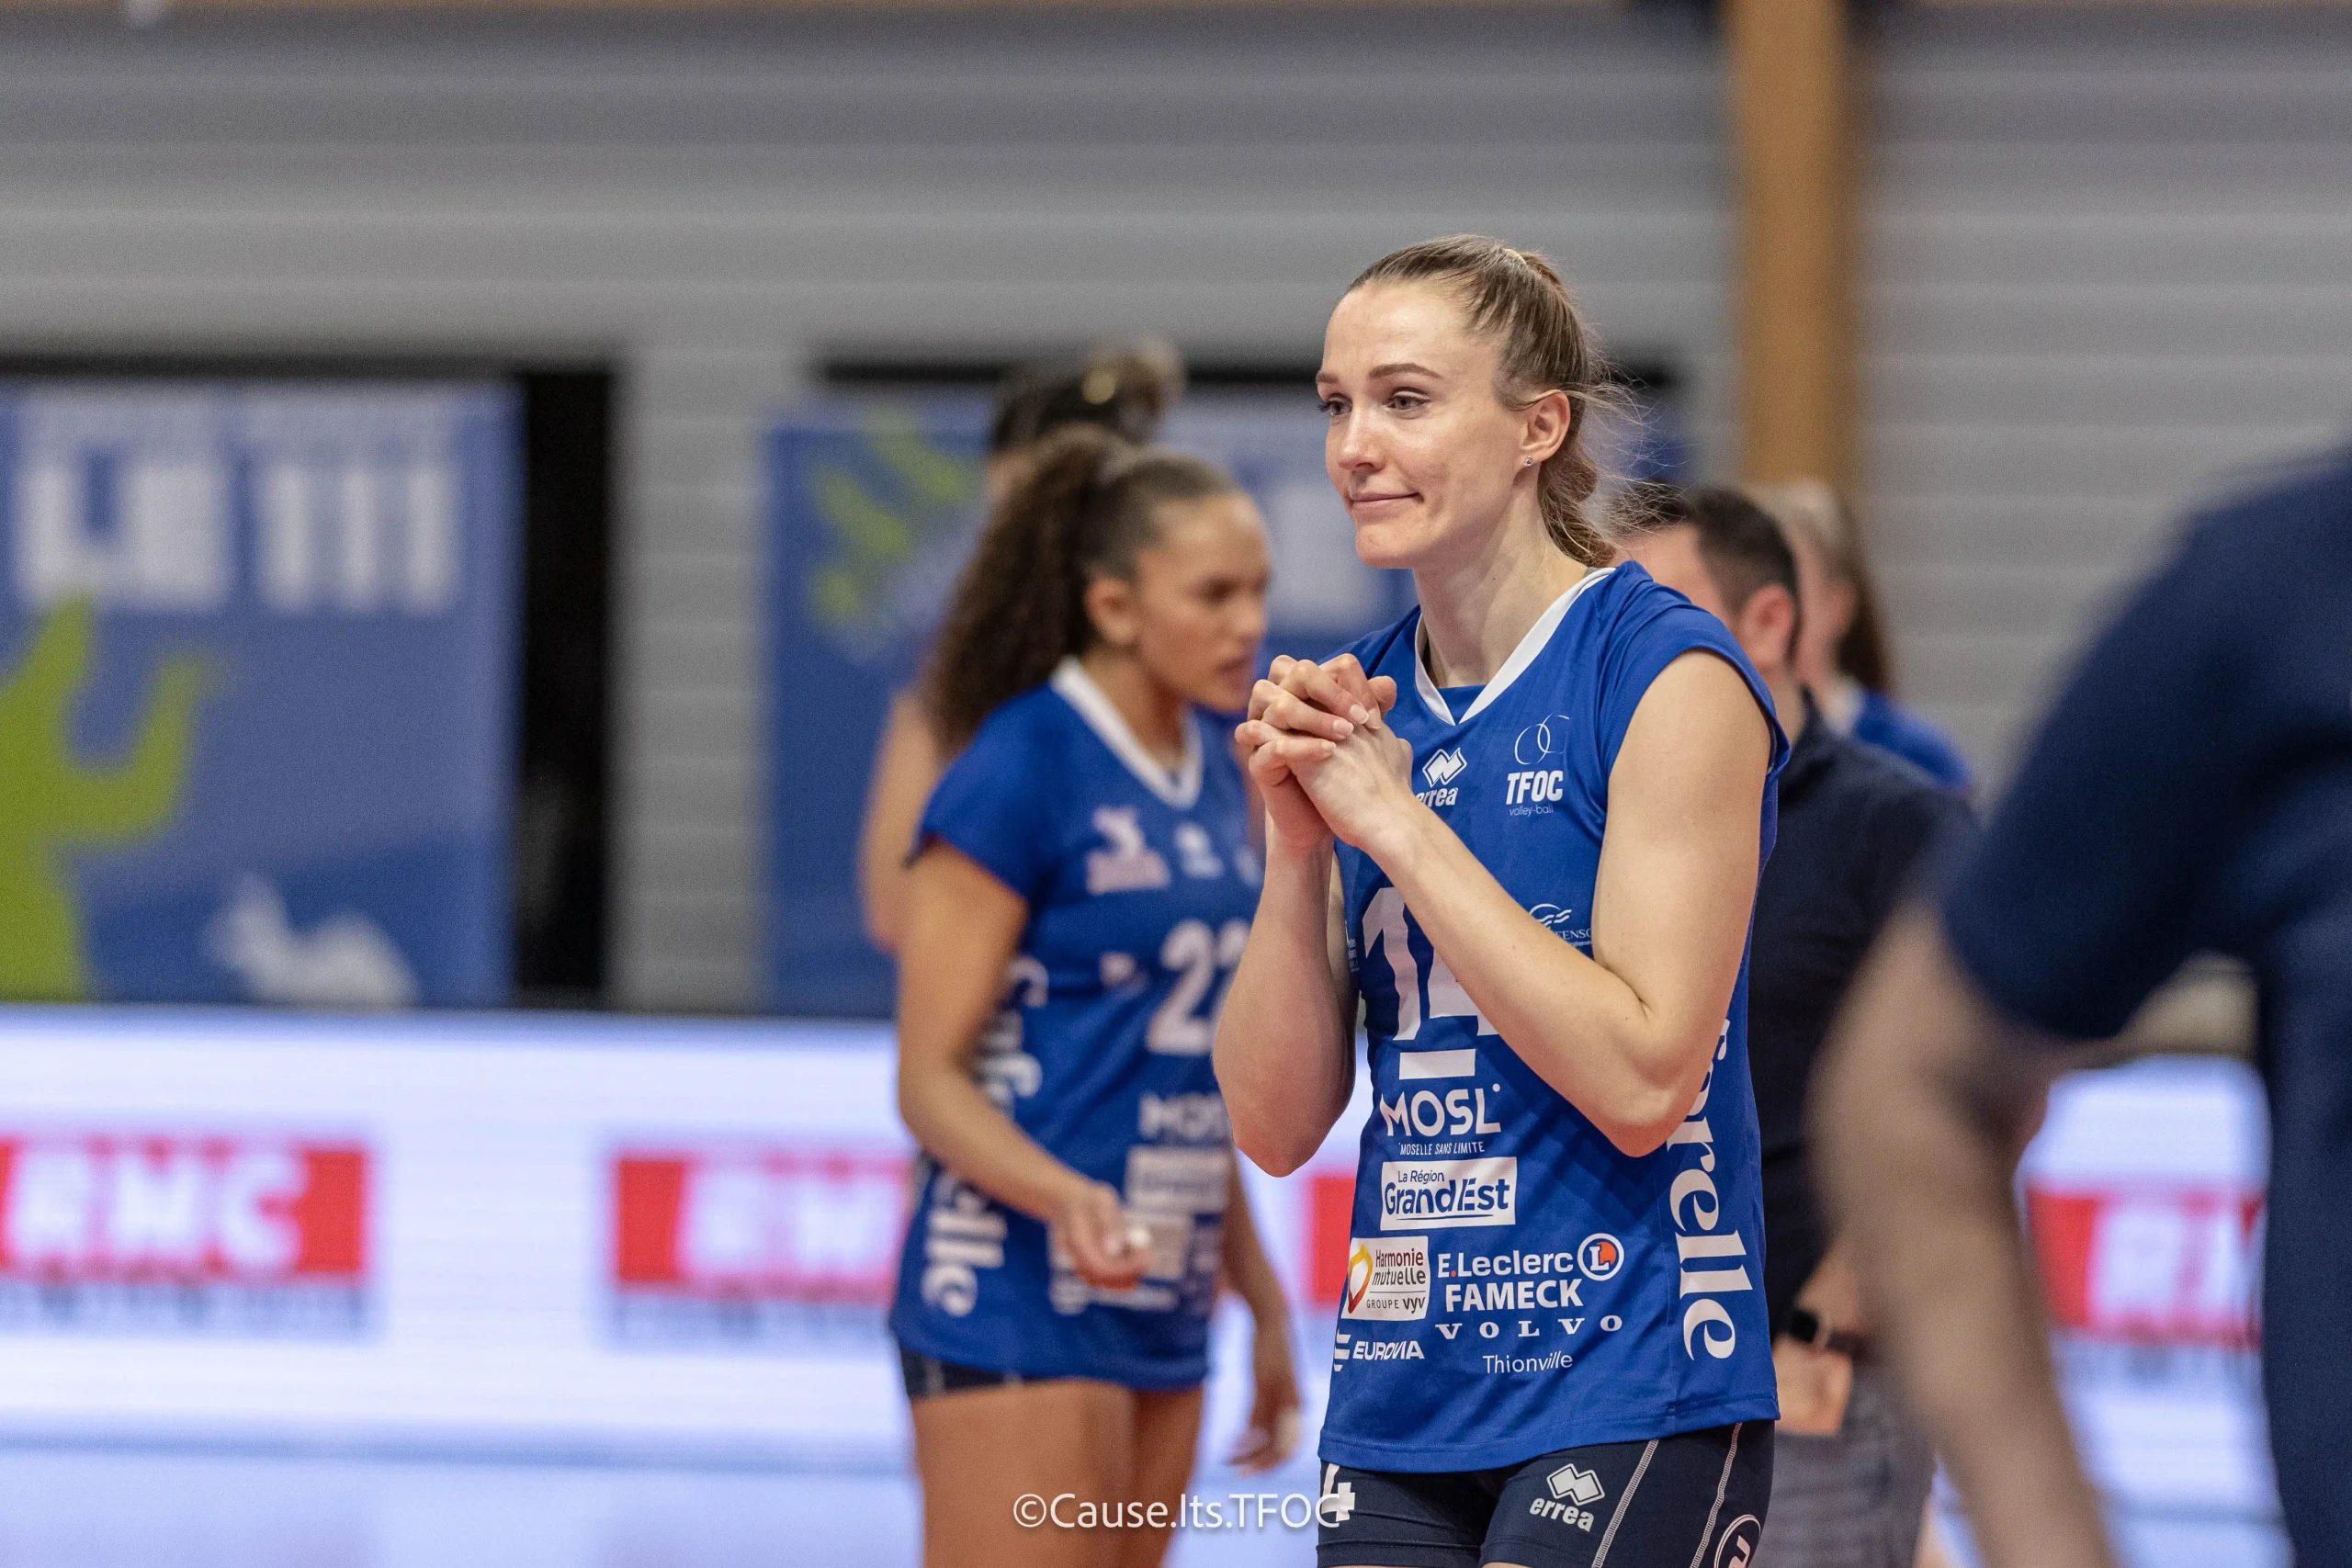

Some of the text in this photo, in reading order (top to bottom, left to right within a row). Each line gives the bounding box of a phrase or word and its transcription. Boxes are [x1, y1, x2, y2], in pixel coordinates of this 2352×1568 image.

[1506, 770, 1564, 805] TFOC
[1509, 803, 1555, 817] volley-ball
[1379, 1088, 1502, 1137] MOSL
[1399, 1141, 1486, 1156] MOSELLE SANS LIMITE
[1397, 1169, 1445, 1185] La Région
[1375, 1247, 1424, 1269] Harmonie
[1437, 1250, 1574, 1278] E.Leclerc
[1372, 1268, 1426, 1286] mutuelle
[1366, 1299, 1400, 1309] GROUPE
[1445, 1279, 1584, 1313] FAMECK
[1435, 1314, 1623, 1340] VOLVO
[1352, 1340, 1426, 1360] EUROVIA
[1482, 1350, 1574, 1374] Thionville
